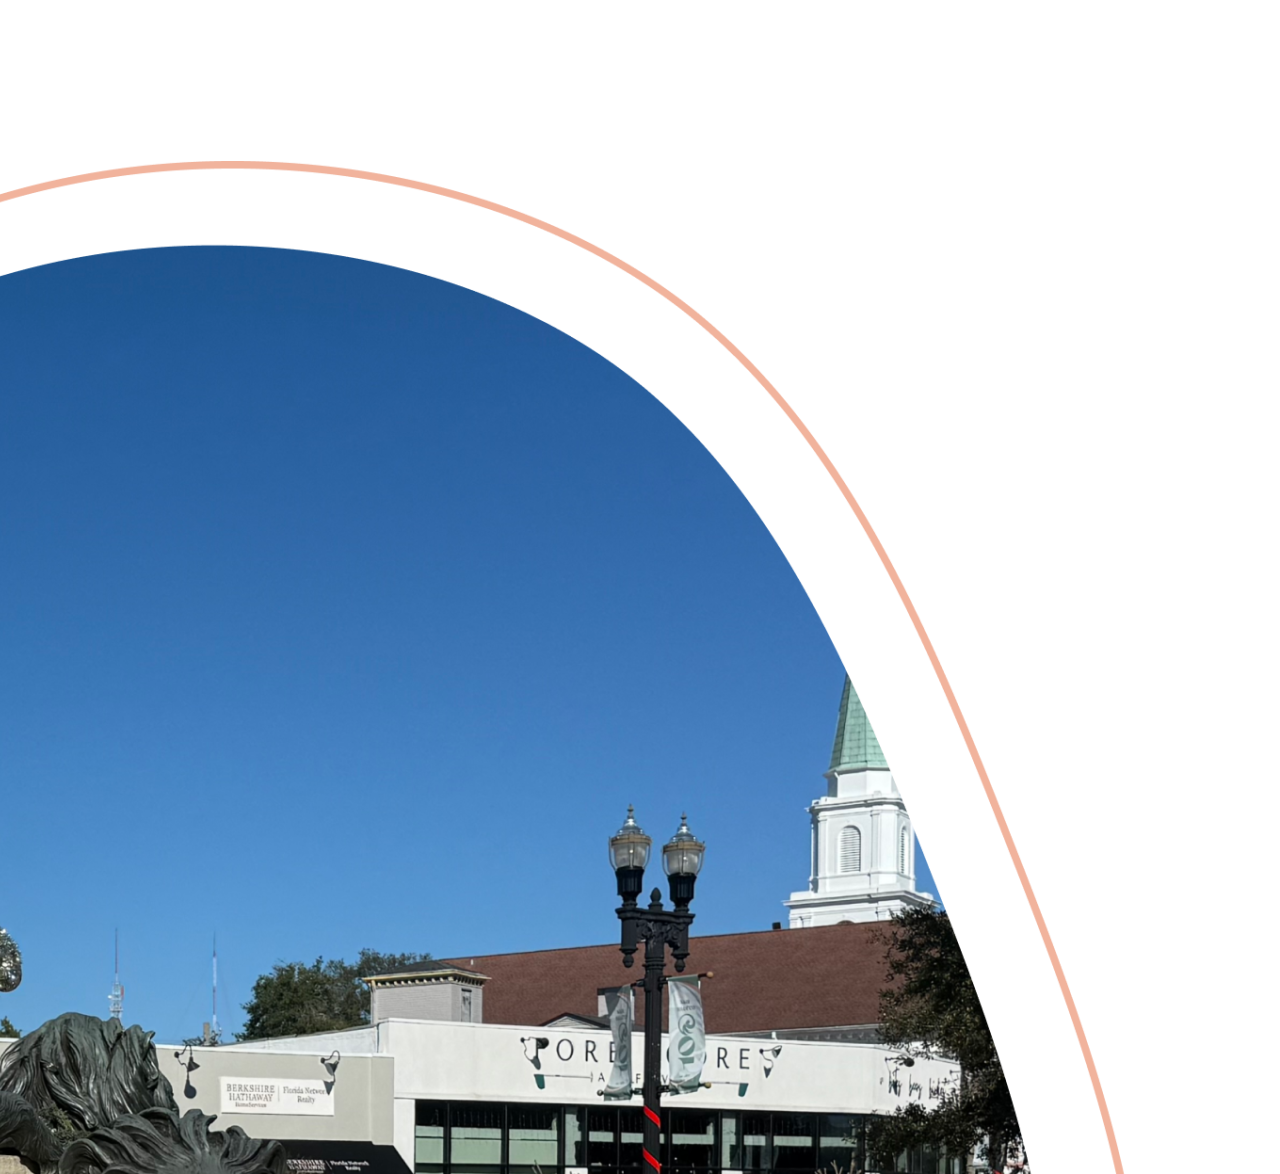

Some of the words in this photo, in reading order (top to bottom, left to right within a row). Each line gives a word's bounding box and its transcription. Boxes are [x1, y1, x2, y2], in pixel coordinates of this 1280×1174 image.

[226, 1083, 275, 1094] BERKSHIRE
[282, 1086, 304, 1095] Florida
[304, 1087, 326, 1095] Networ
[228, 1092, 274, 1102] HATHAWAY
[297, 1096, 316, 1105] Realty
